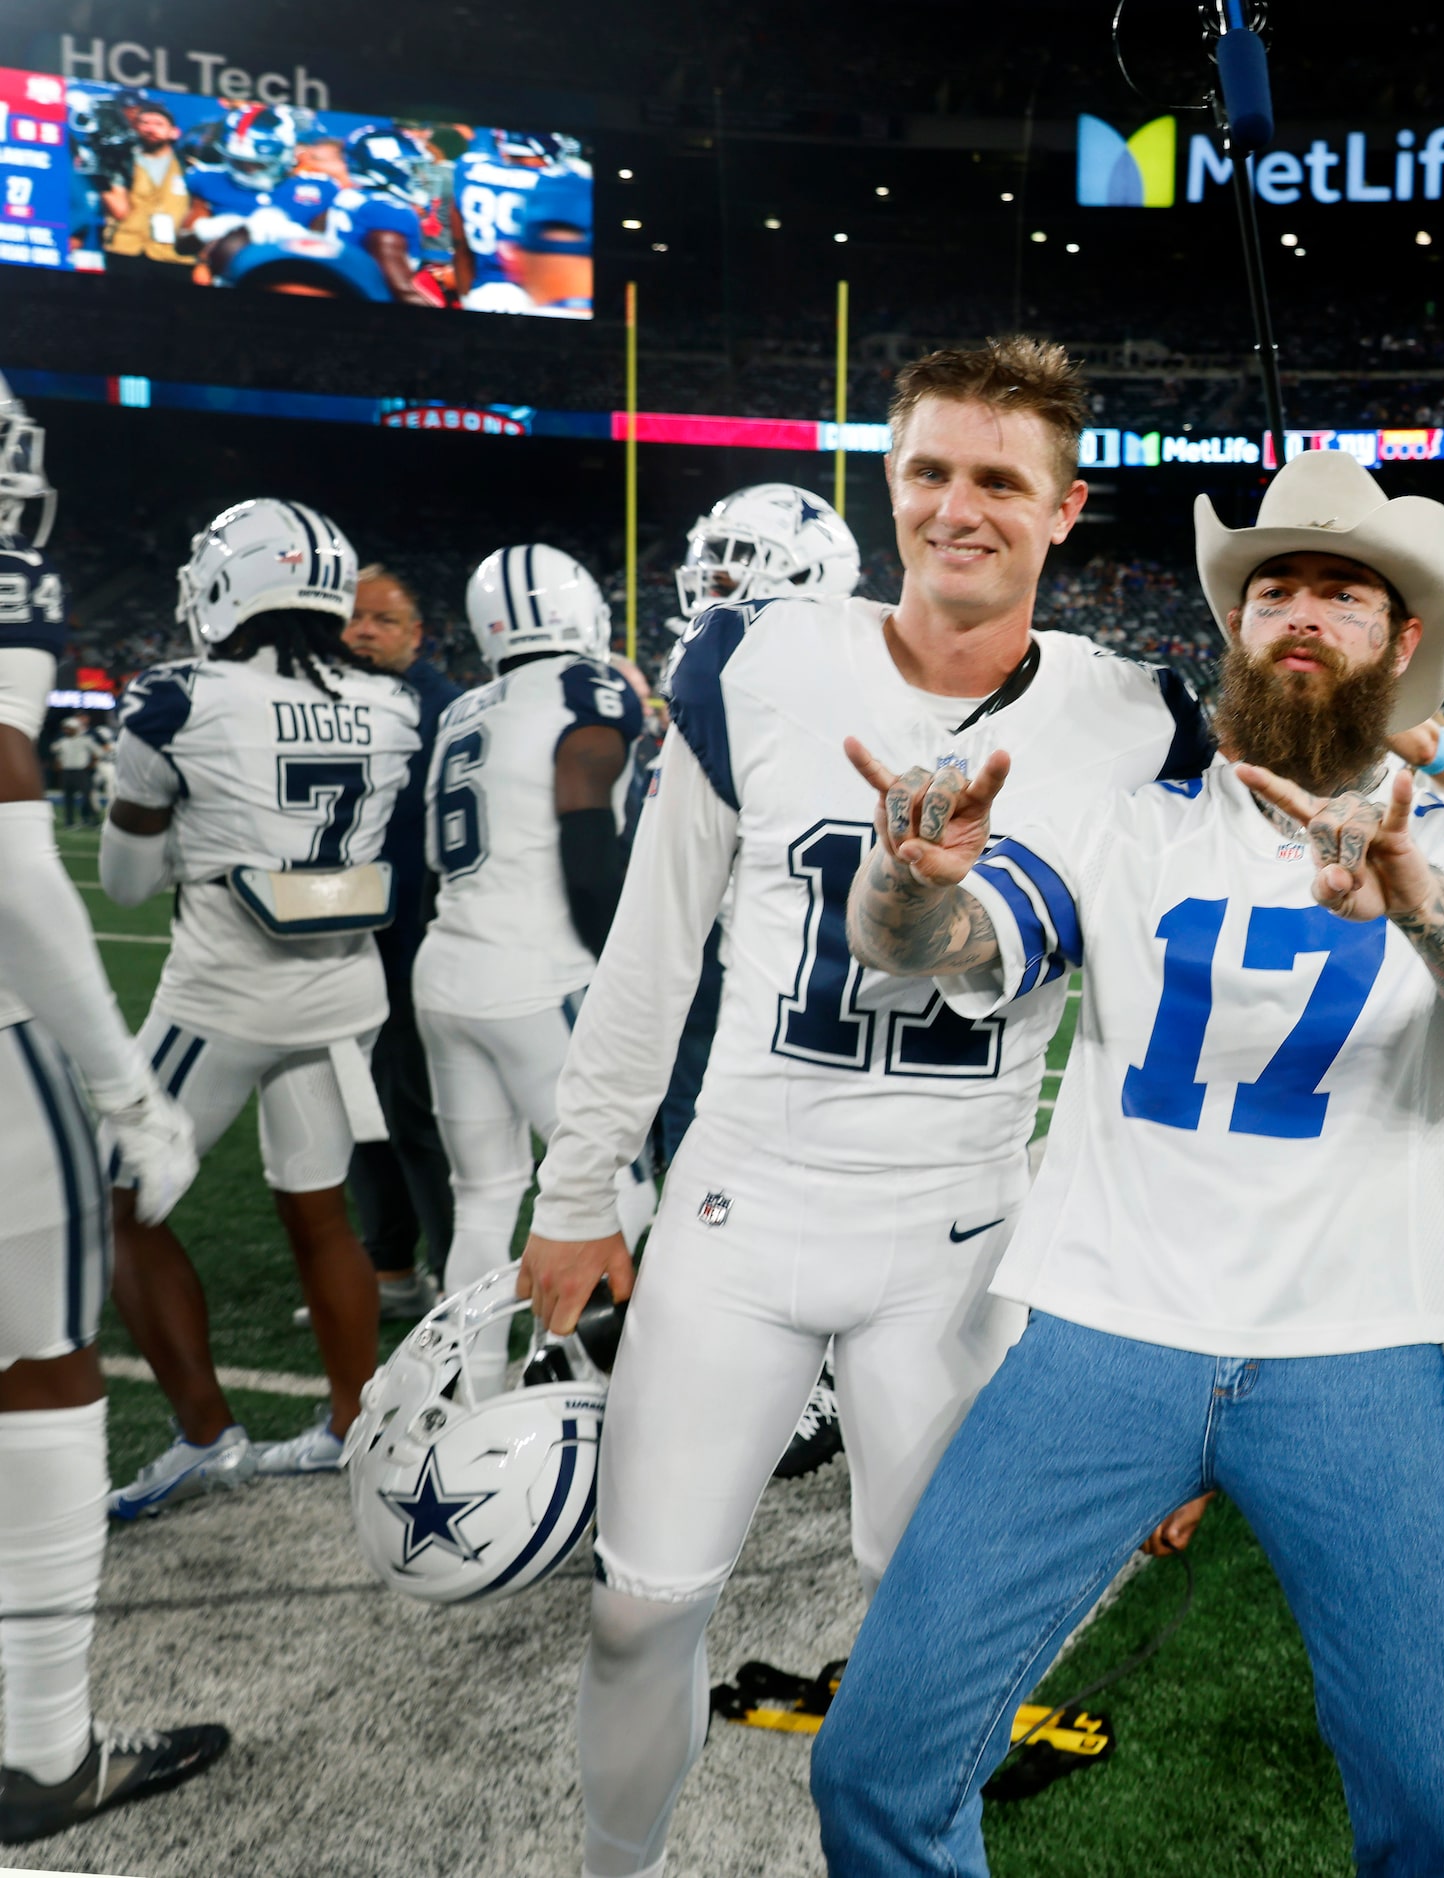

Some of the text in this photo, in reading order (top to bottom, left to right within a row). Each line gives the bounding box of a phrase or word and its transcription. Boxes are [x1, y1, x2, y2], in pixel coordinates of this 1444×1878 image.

[60, 33, 329, 110] HCLTech
[1162, 435, 1260, 465] MetLife
[271, 701, 372, 746] DIGGS
[593, 687, 625, 720] 6
[276, 753, 376, 875] 7
[426, 722, 491, 882] 6
[1122, 896, 1387, 1140] 17
